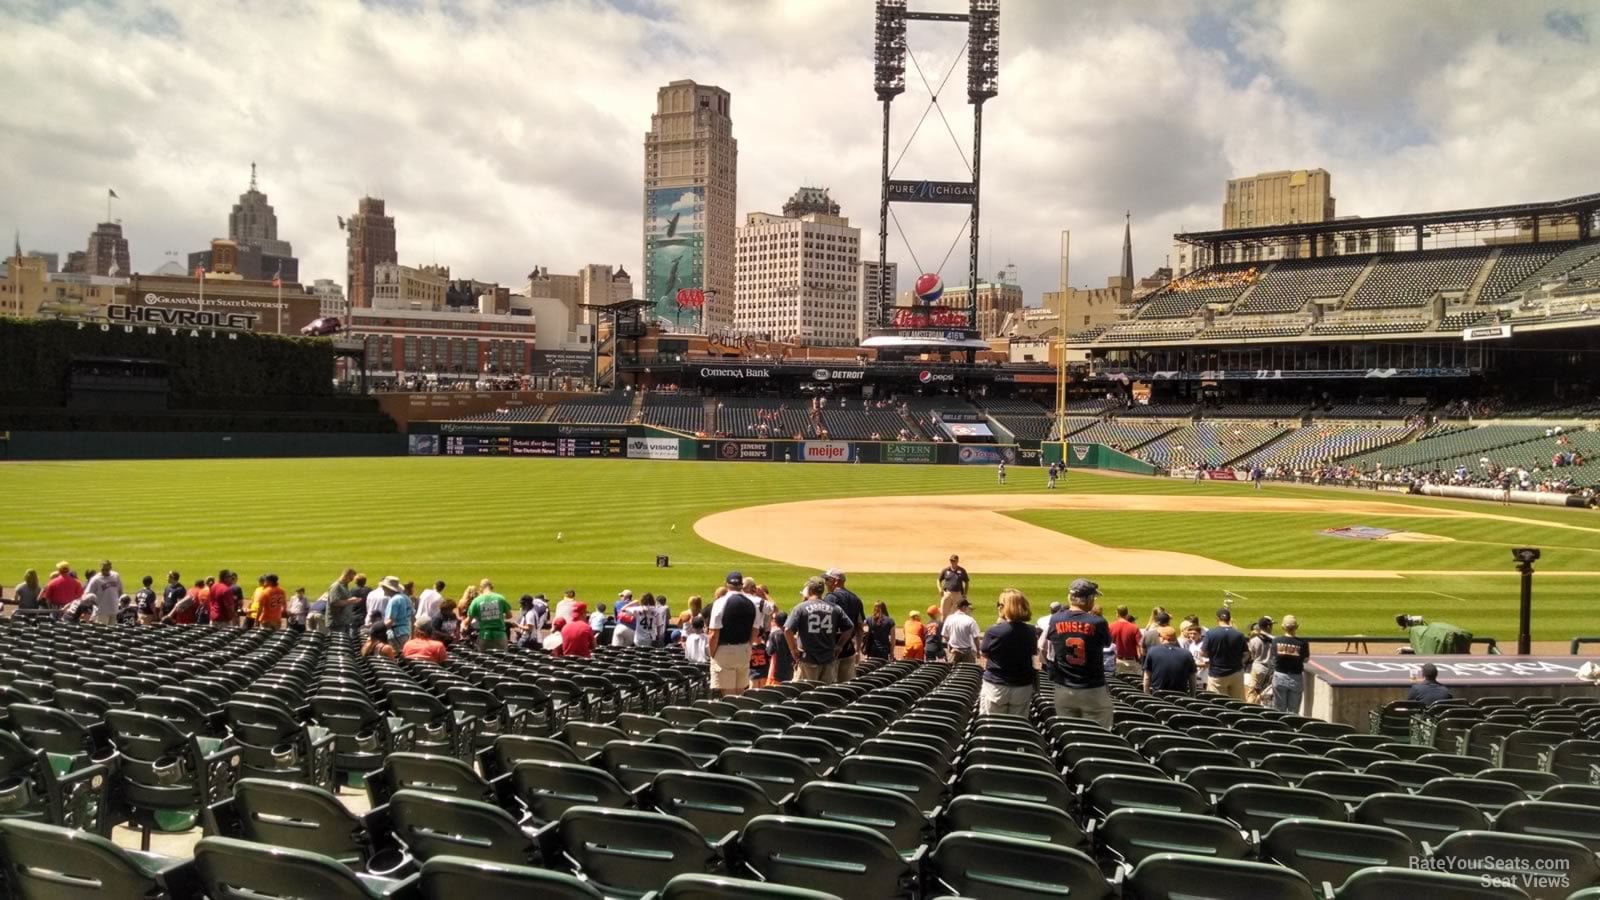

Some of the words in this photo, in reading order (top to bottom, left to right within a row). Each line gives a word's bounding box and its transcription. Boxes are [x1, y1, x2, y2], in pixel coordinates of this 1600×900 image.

[889, 184, 914, 194] PURE
[157, 295, 187, 304] GRAND
[216, 299, 241, 307] STATE
[241, 300, 289, 309] UNIVERSITY
[107, 304, 260, 330] CHEVROLET
[77, 322, 237, 340] FOUNTAIN
[746, 368, 770, 378] Bank
[832, 370, 865, 379] DETROIT
[932, 374, 954, 384] pepsi
[808, 444, 845, 458] meijer
[887, 444, 931, 454] EASTERN
[639, 617, 654, 630] 41
[808, 614, 834, 634] 24
[1065, 637, 1086, 666] 3
